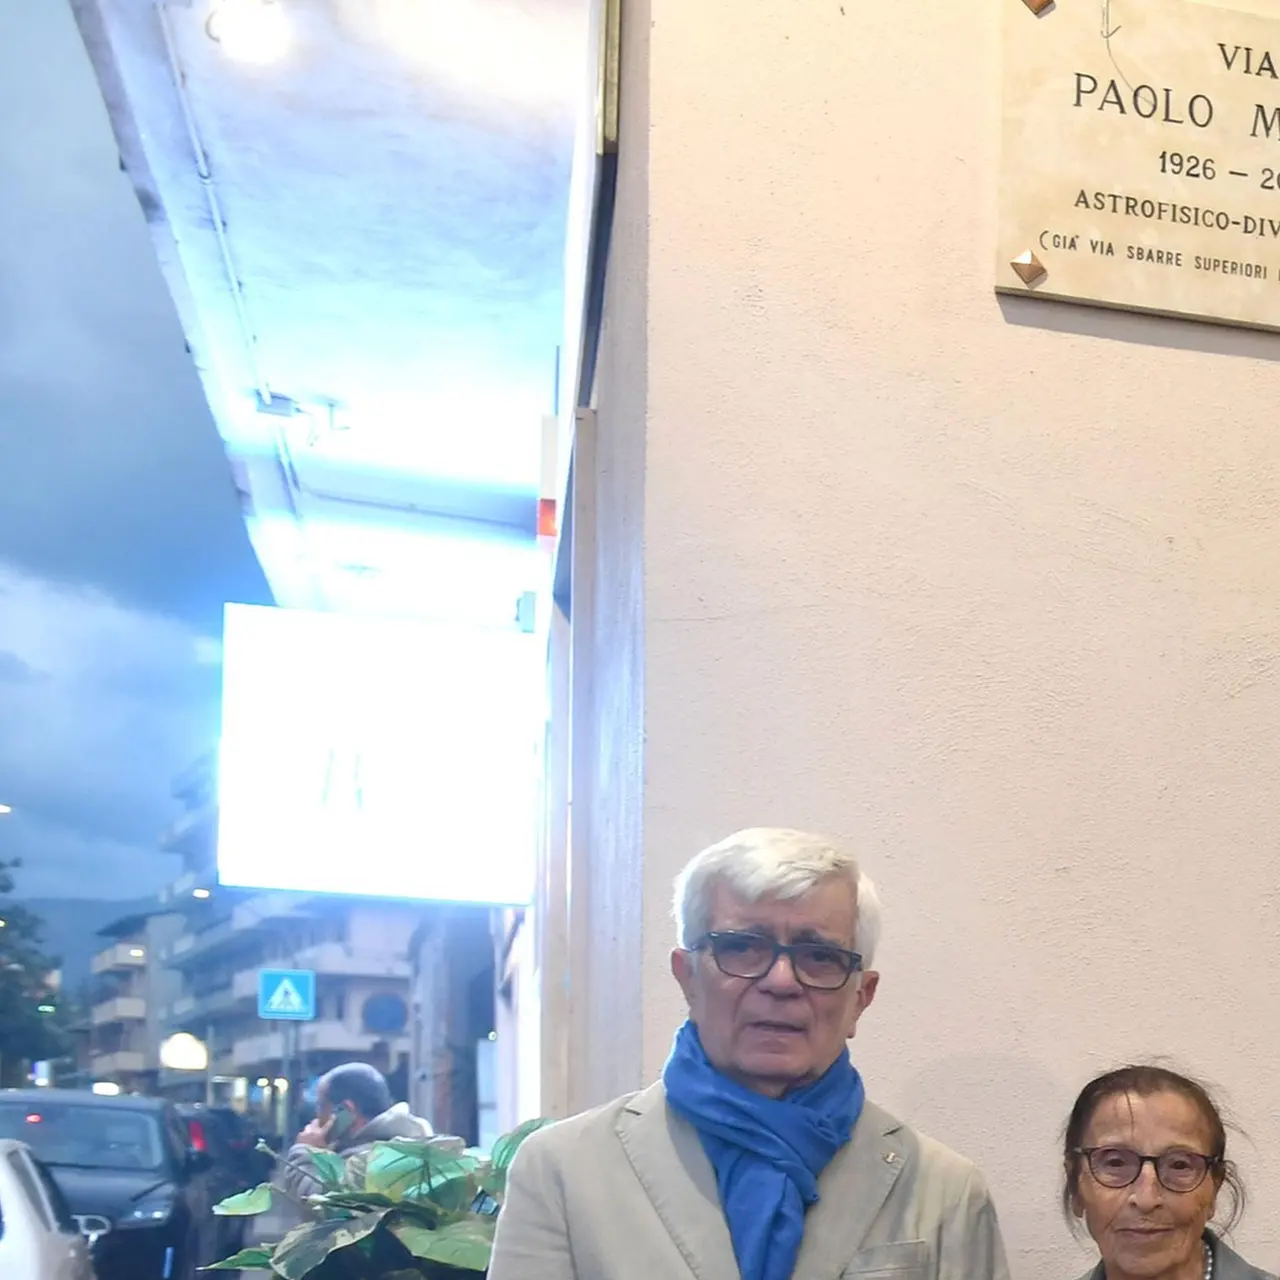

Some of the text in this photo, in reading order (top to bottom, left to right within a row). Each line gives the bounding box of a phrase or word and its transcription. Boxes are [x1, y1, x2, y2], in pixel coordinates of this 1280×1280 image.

[1217, 43, 1279, 80] VIA
[1073, 72, 1213, 128] PAOLO
[1158, 150, 1216, 181] 1926
[1090, 239, 1115, 256] VIA
[1127, 245, 1184, 267] SBARRE
[1194, 255, 1268, 280] SUPERIORI
